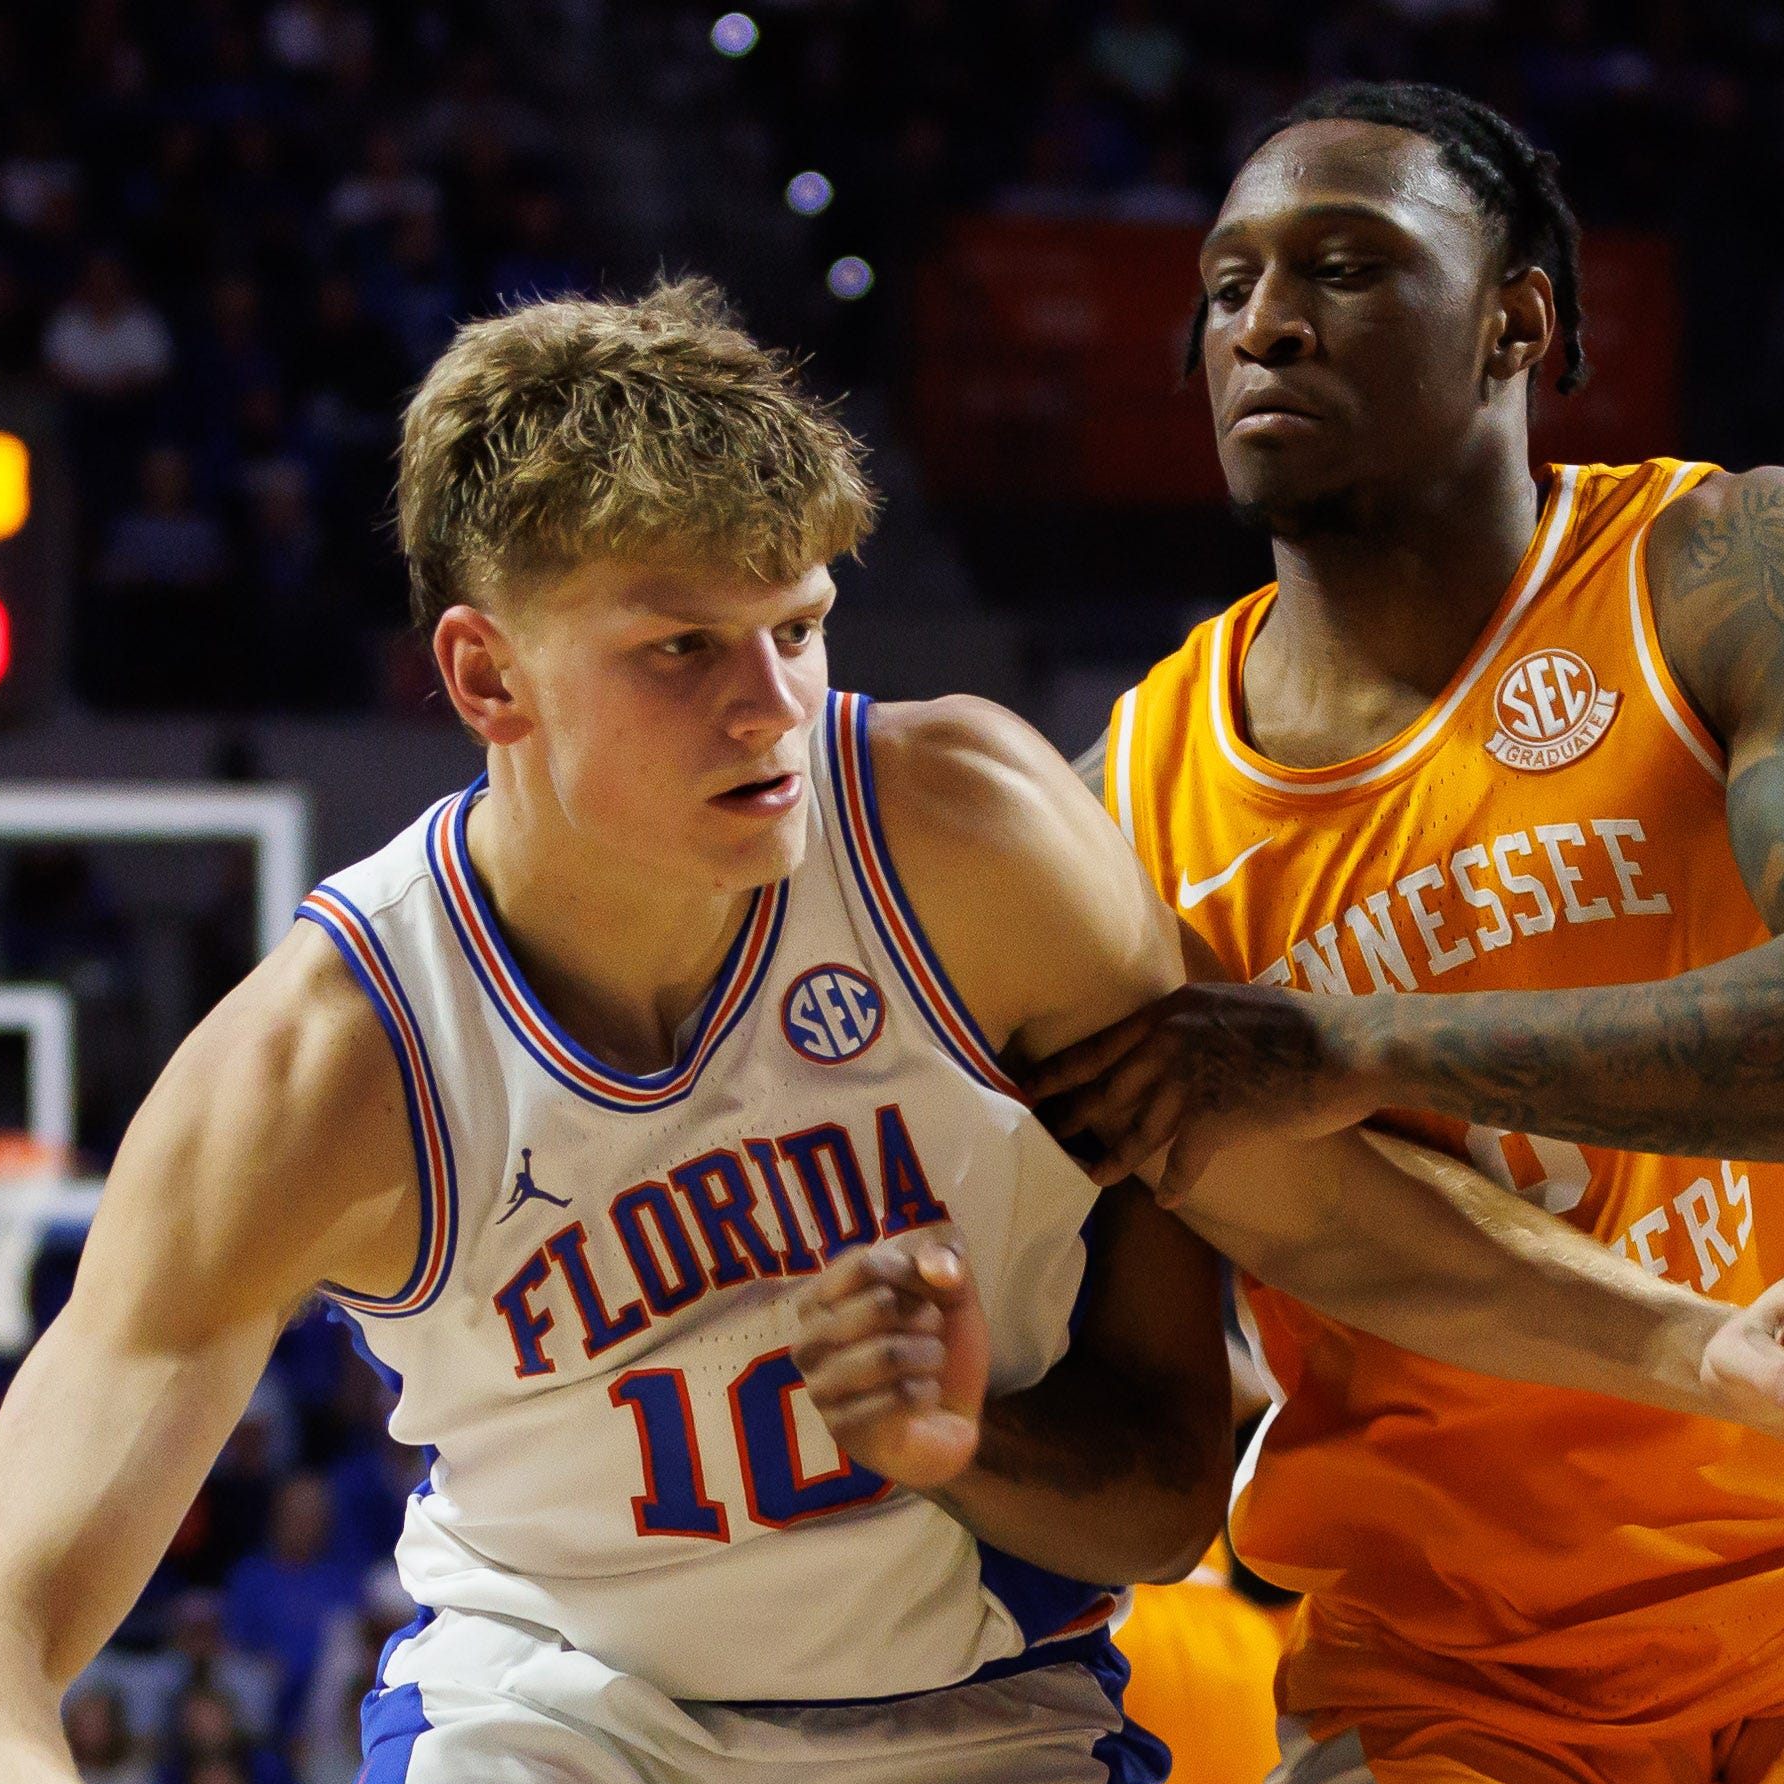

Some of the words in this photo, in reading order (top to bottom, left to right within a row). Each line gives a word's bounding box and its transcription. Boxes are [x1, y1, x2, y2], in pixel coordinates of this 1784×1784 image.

[1501, 655, 1587, 739] SEC
[1504, 711, 1608, 768] GRADUATE
[1249, 818, 1674, 997] NNESSEE
[788, 972, 879, 1060] SEC
[493, 1102, 953, 1378] FLORIDA
